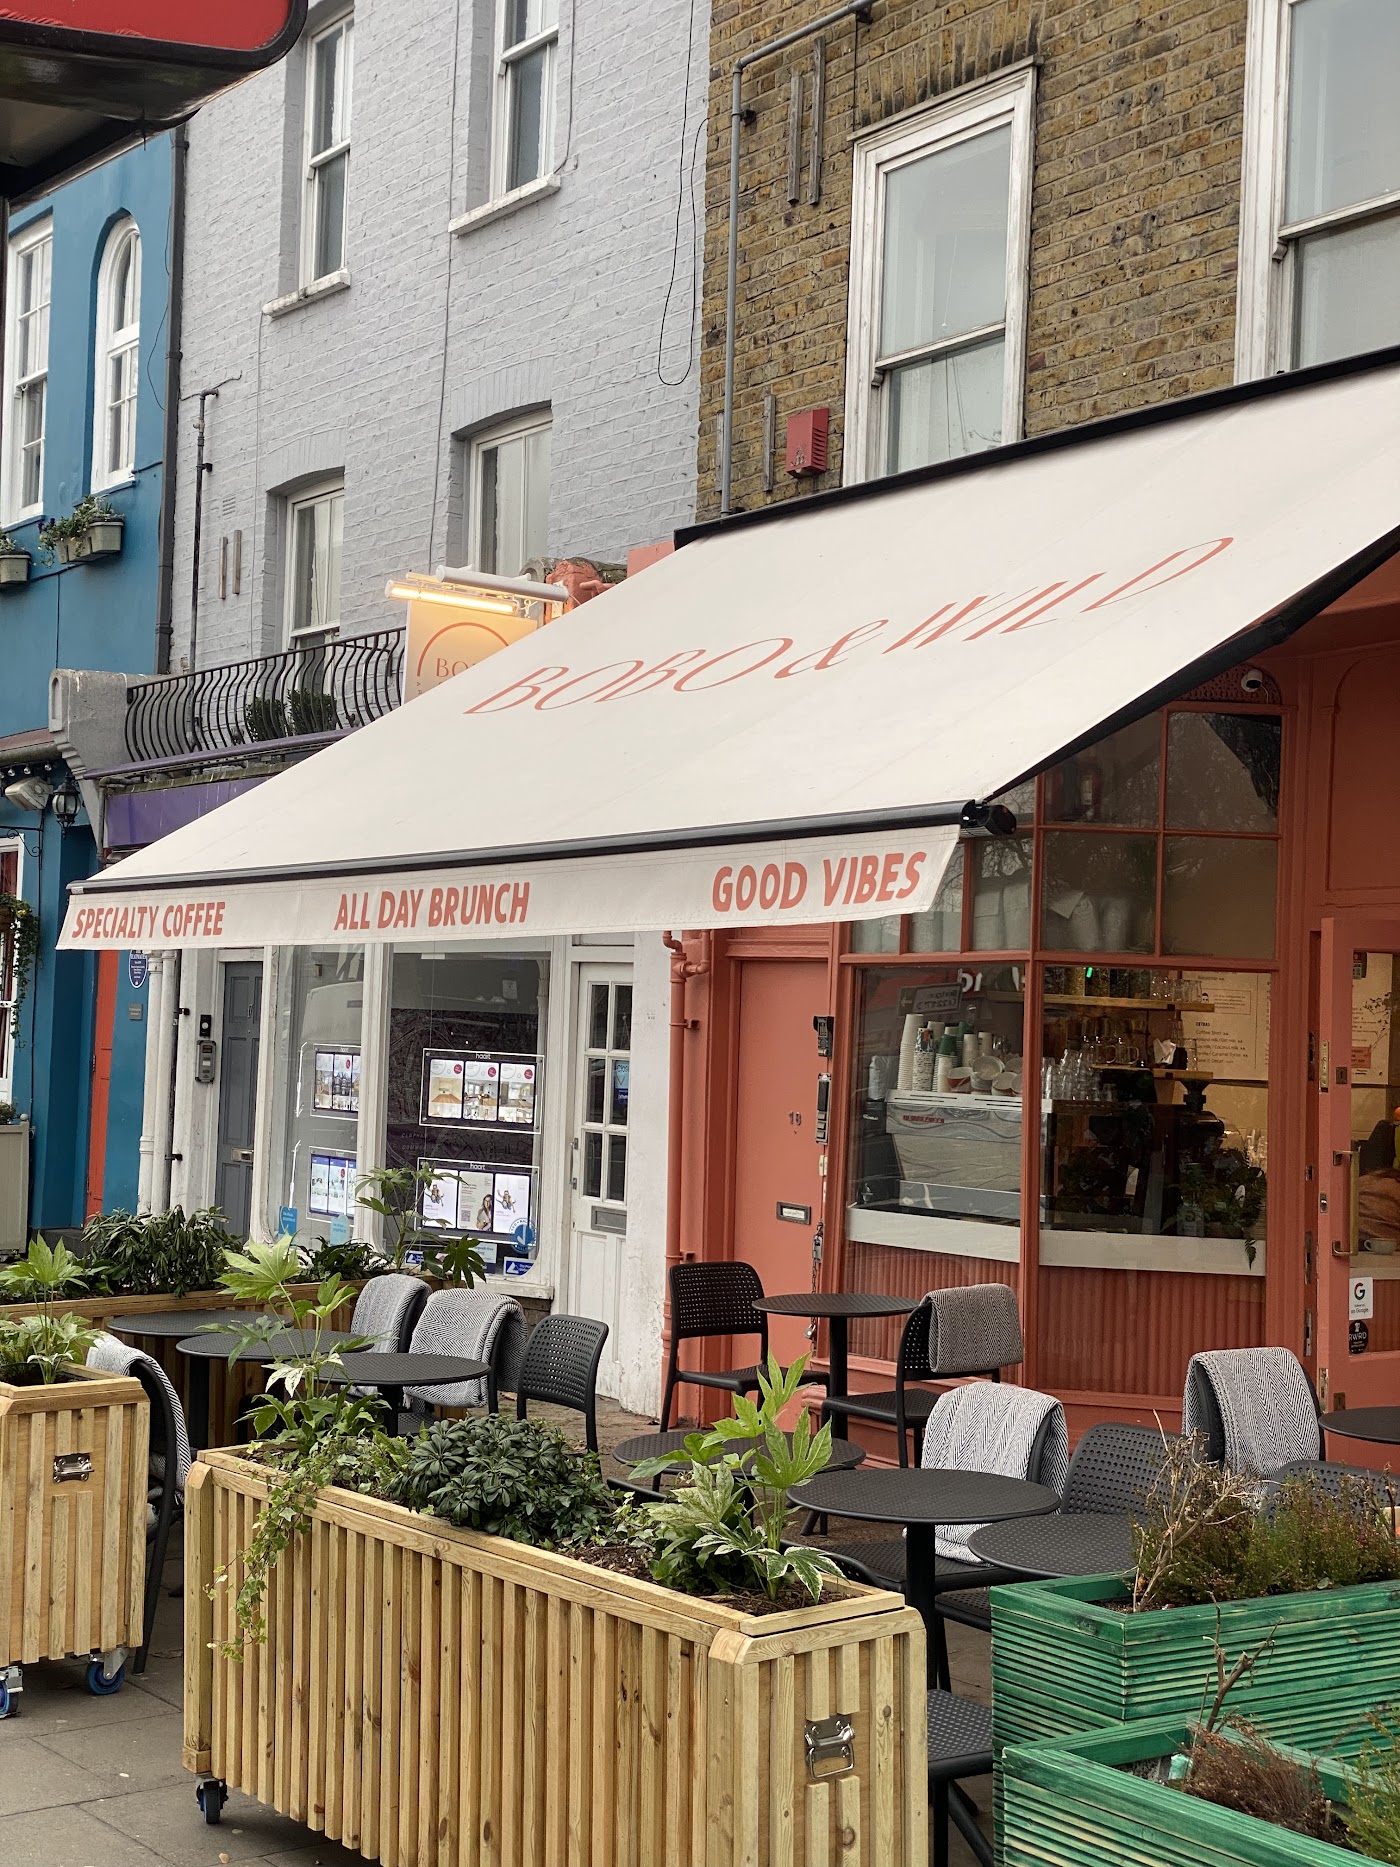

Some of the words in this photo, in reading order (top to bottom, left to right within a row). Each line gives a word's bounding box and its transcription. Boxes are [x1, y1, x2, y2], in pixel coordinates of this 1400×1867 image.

[464, 637, 794, 715] BOBO
[774, 618, 888, 680] &
[882, 537, 1234, 653] WILD
[436, 658, 477, 678] BO
[711, 863, 808, 911] GOOD
[822, 852, 927, 906] VIBES
[72, 905, 159, 939] SPECIALTY
[162, 902, 226, 937] COFFEE
[335, 891, 370, 931] ALL
[377, 889, 424, 929] DAY
[428, 882, 531, 927] BRUNCH
[469, 1162, 486, 1171] haart
